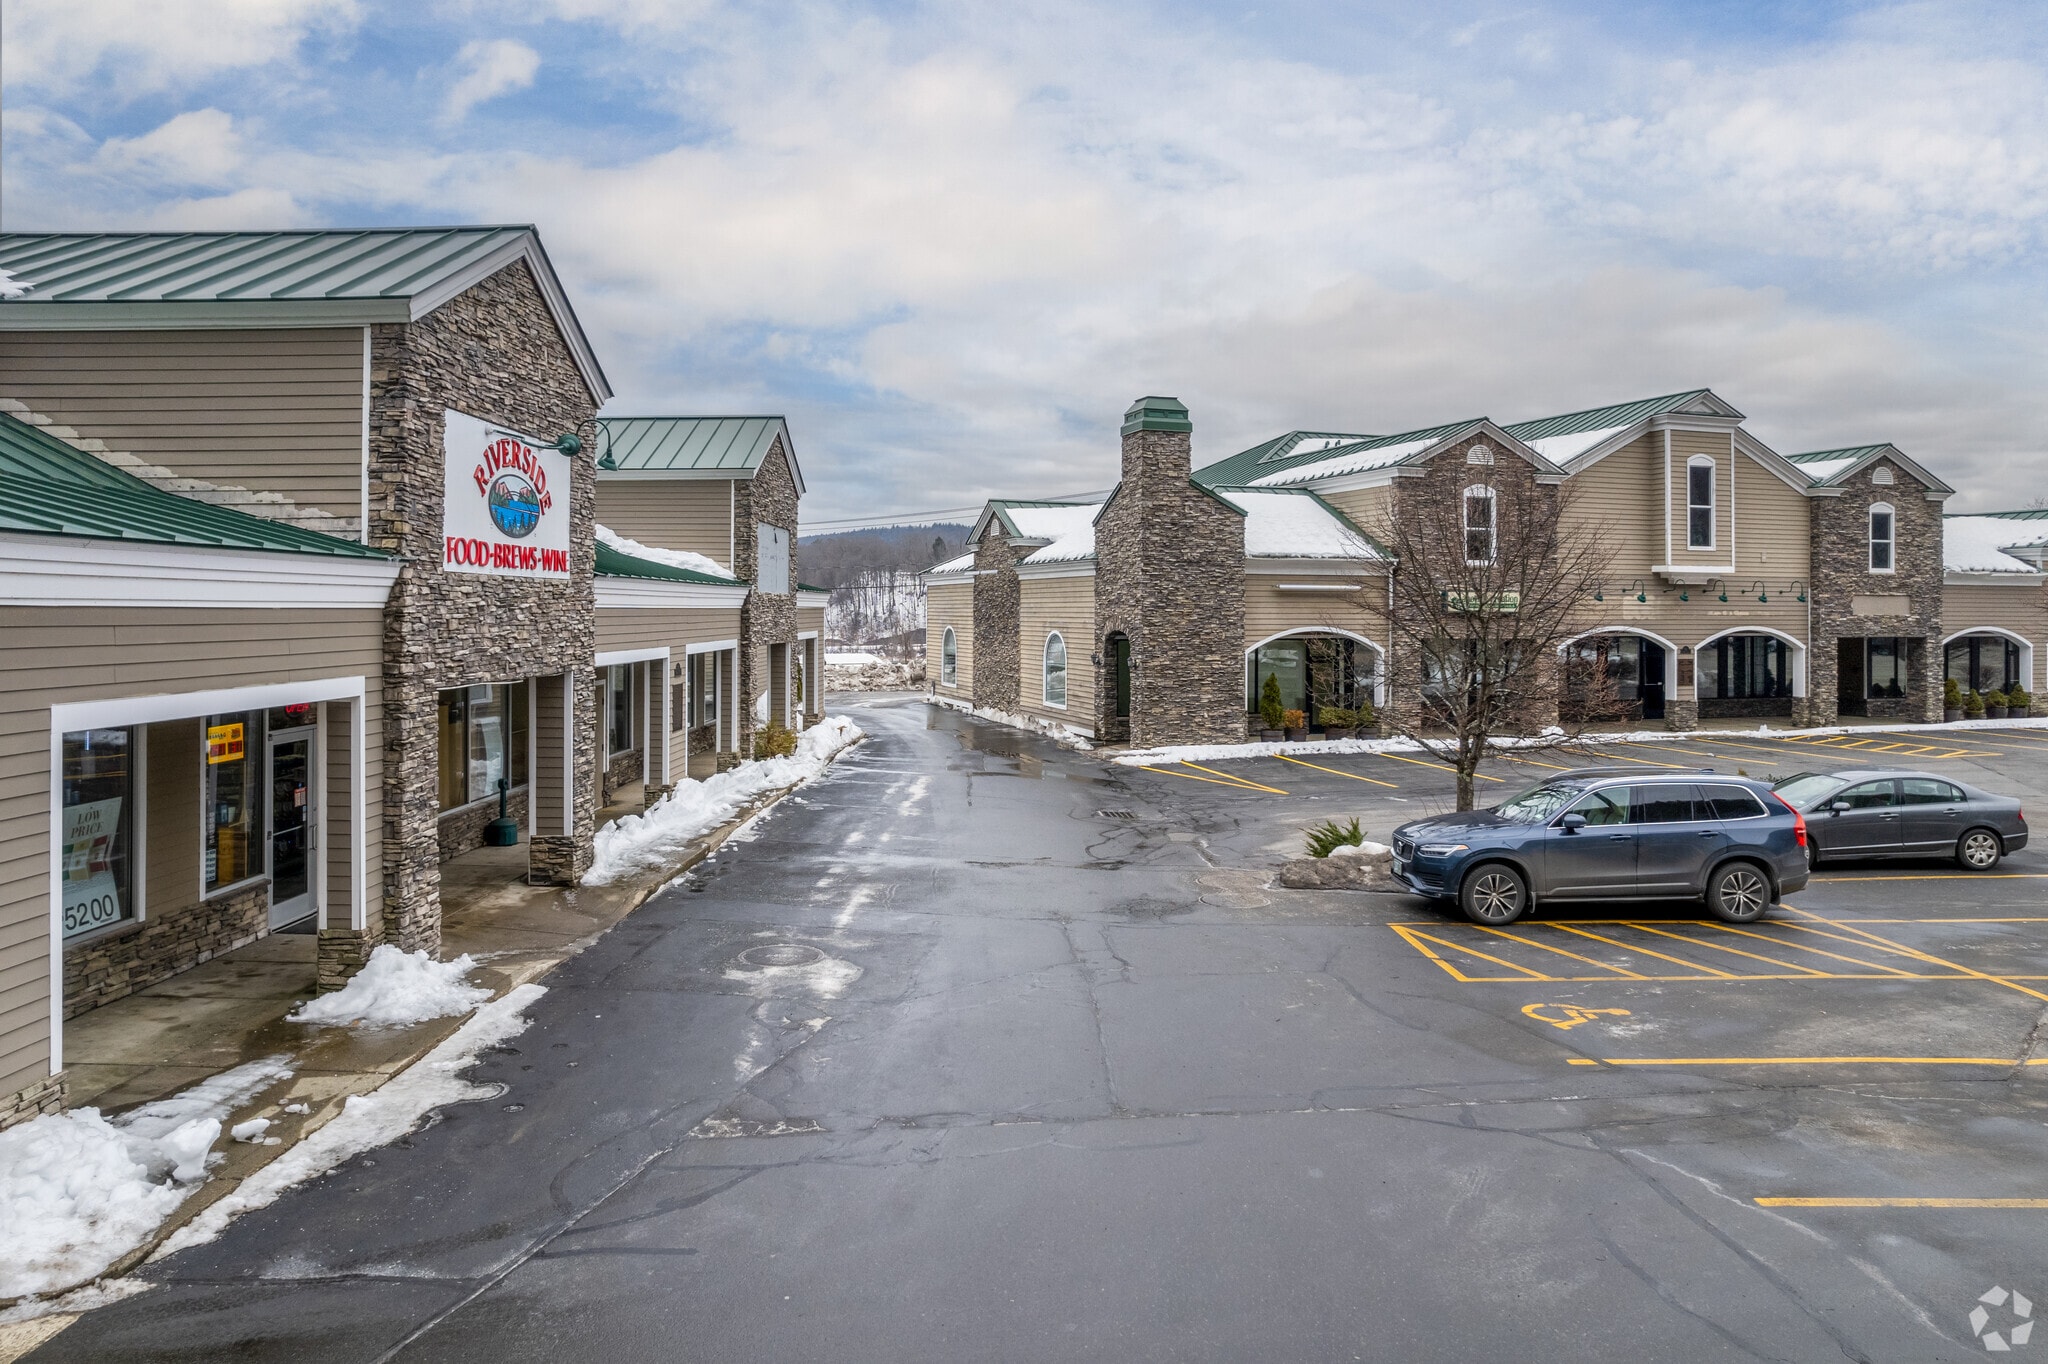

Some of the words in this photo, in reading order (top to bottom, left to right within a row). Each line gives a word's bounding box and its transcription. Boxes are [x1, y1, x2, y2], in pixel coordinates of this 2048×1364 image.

[473, 438, 552, 516] RIVERSIDE
[70, 821, 104, 839] PRICE
[77, 809, 103, 825] LOW
[62, 894, 114, 931] 52.00
